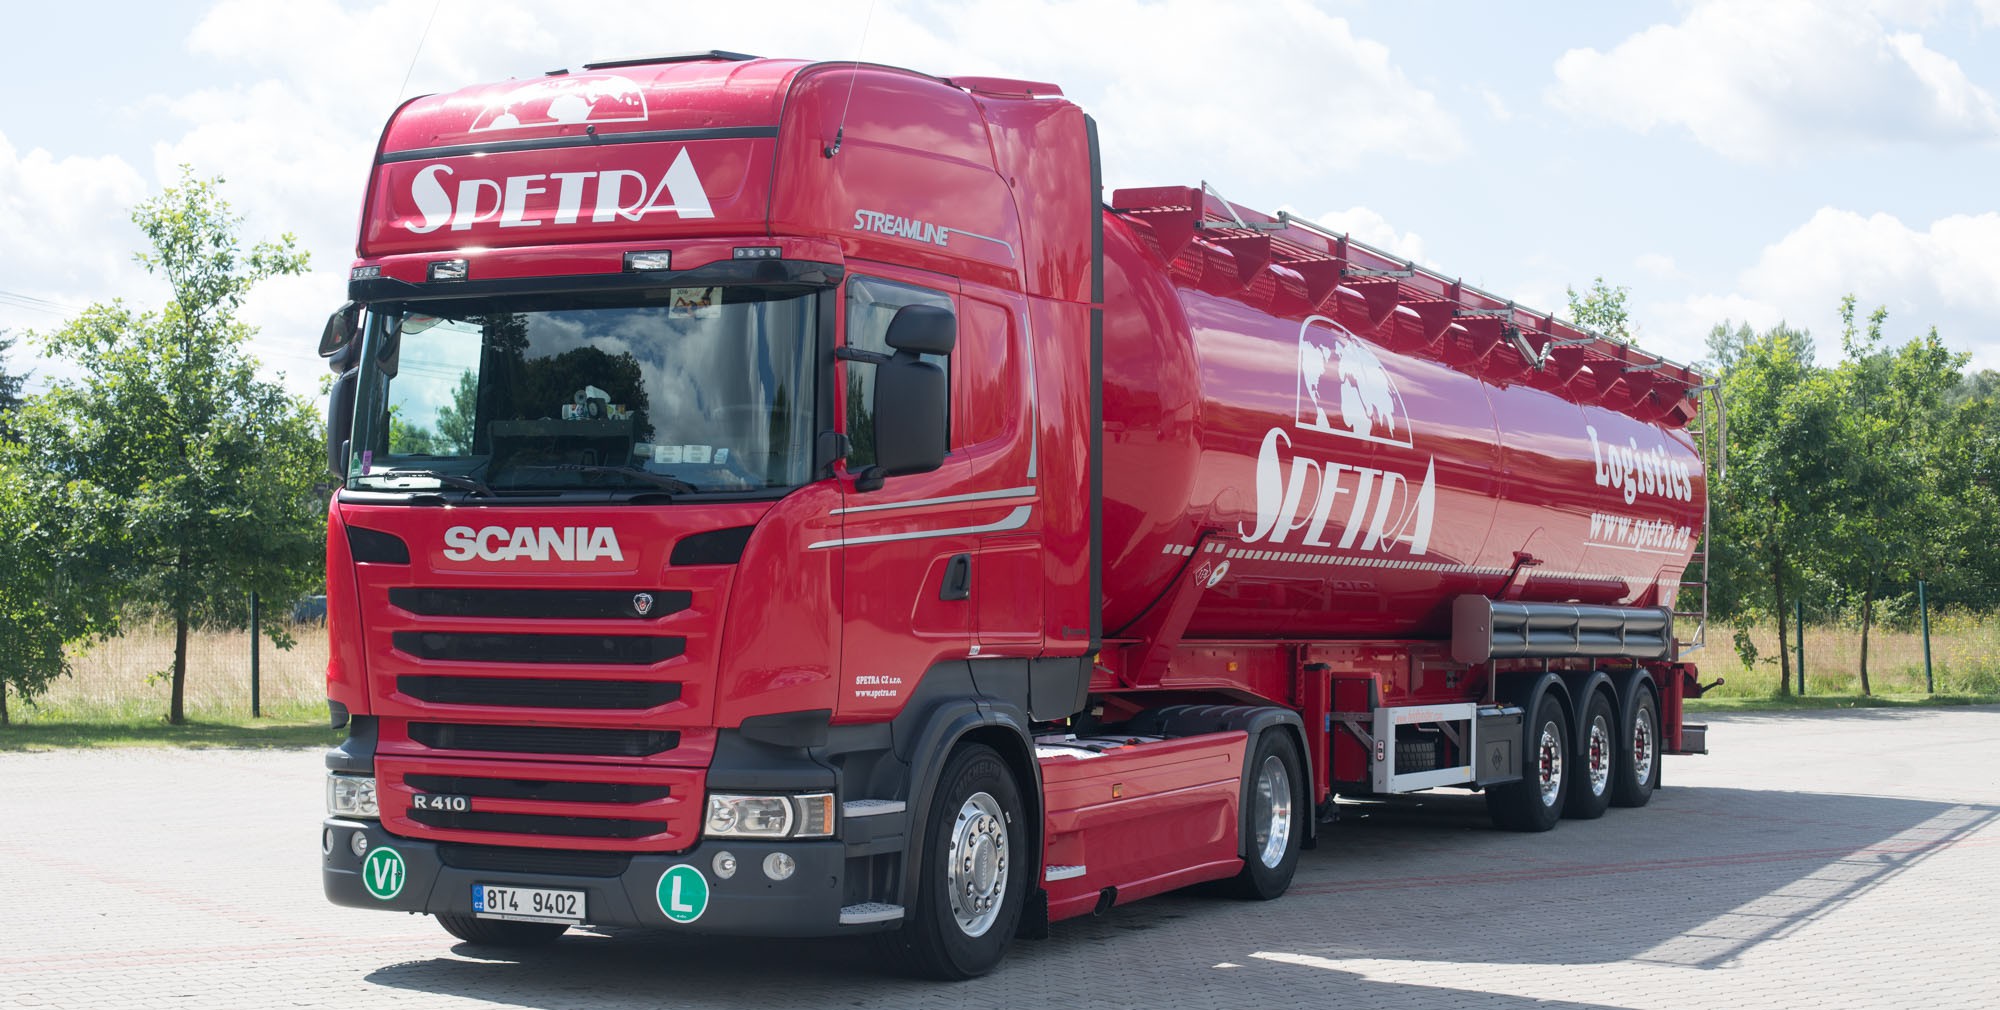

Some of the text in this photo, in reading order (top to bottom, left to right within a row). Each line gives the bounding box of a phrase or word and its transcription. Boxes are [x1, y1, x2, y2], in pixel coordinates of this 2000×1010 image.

[404, 145, 715, 234] SPETRA
[853, 208, 949, 247] STREAMLINE
[1586, 425, 1692, 505] Logistics
[1238, 427, 1436, 556] SPETRA
[443, 525, 625, 562] SCANIA
[1589, 512, 1691, 553] www.spetra.cz
[855, 675, 880, 685] SPETRA
[881, 675, 889, 684] CZ
[414, 795, 466, 811] R 410
[372, 857, 398, 891] VI
[487, 889, 577, 915] 8T4 9402
[671, 875, 693, 913] L
